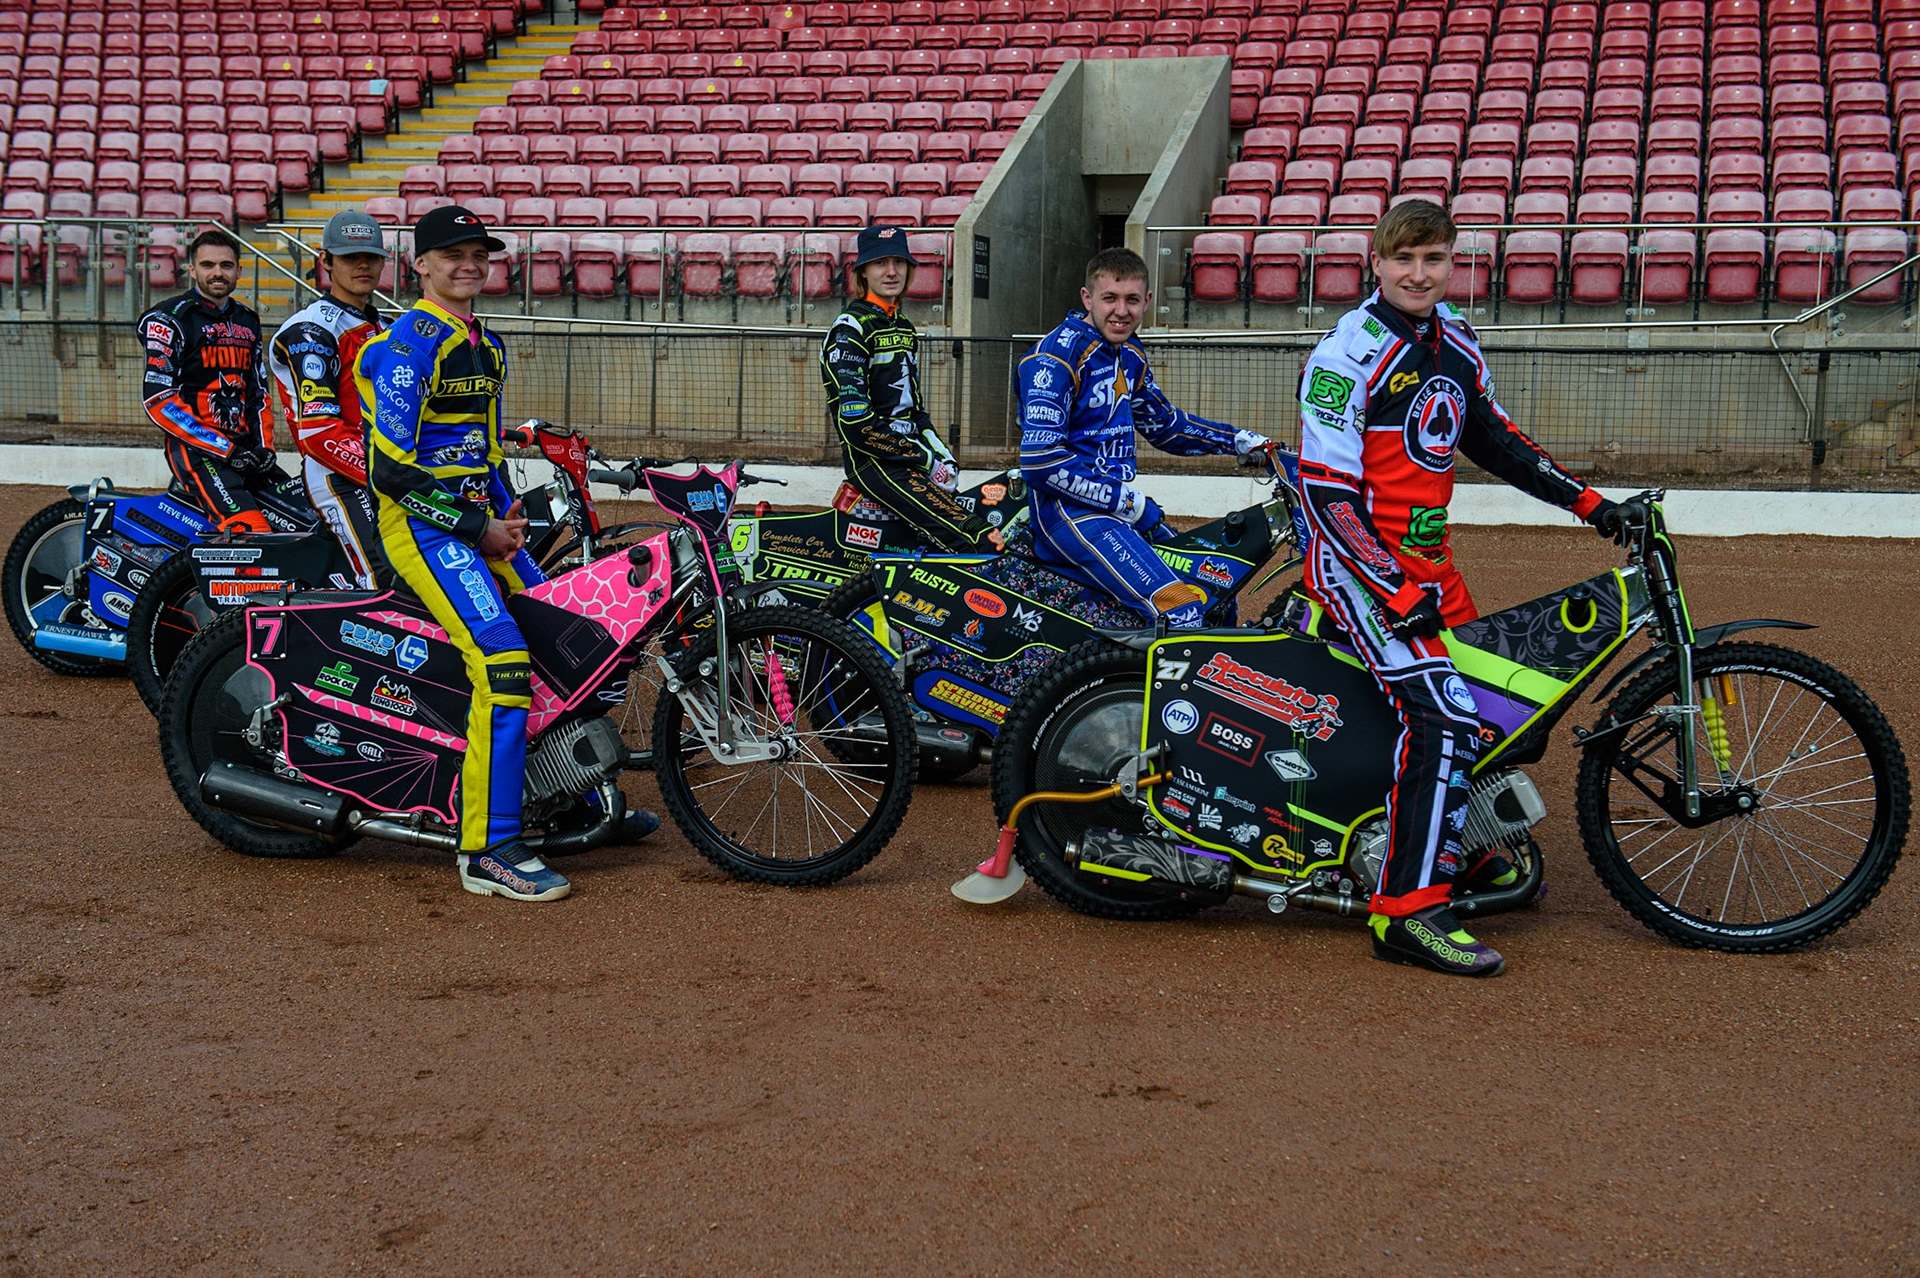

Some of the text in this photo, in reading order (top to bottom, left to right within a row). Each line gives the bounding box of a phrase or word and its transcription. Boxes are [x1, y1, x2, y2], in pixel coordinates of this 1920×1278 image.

[149, 323, 171, 339] NGK
[288, 340, 334, 356] wefco
[376, 374, 411, 413] PlanCon
[1411, 386, 1433, 419] BELLE
[1068, 474, 1113, 504] MRC
[90, 508, 108, 530] 7
[157, 501, 204, 532] STEVE WARE
[401, 495, 456, 528] ROCK OIL
[730, 524, 752, 553] 6
[761, 529, 824, 547] Complete Car
[849, 524, 881, 542] NGK
[1101, 530, 1123, 556] Brady
[768, 541, 835, 559] Services Ltd
[883, 544, 911, 555] Suffolk
[1118, 549, 1132, 563] &
[909, 567, 961, 596] RUSTY
[970, 592, 1002, 610] IWADE
[43, 623, 106, 642] ERNEST HAWK
[255, 617, 284, 655] 7
[339, 619, 396, 651] PBHS
[373, 646, 389, 657] LTD
[319, 672, 356, 691] ROCK OIL
[1209, 652, 1317, 708] Speculate
[1766, 666, 1817, 687] PLATINUM
[932, 679, 1007, 714] SPEEDWA
[1209, 669, 1305, 719] Accumulate
[1166, 708, 1194, 727] ATPI
[1210, 723, 1254, 750] BOSS
[479, 856, 538, 895] daytona
[1404, 918, 1478, 966] daytona
